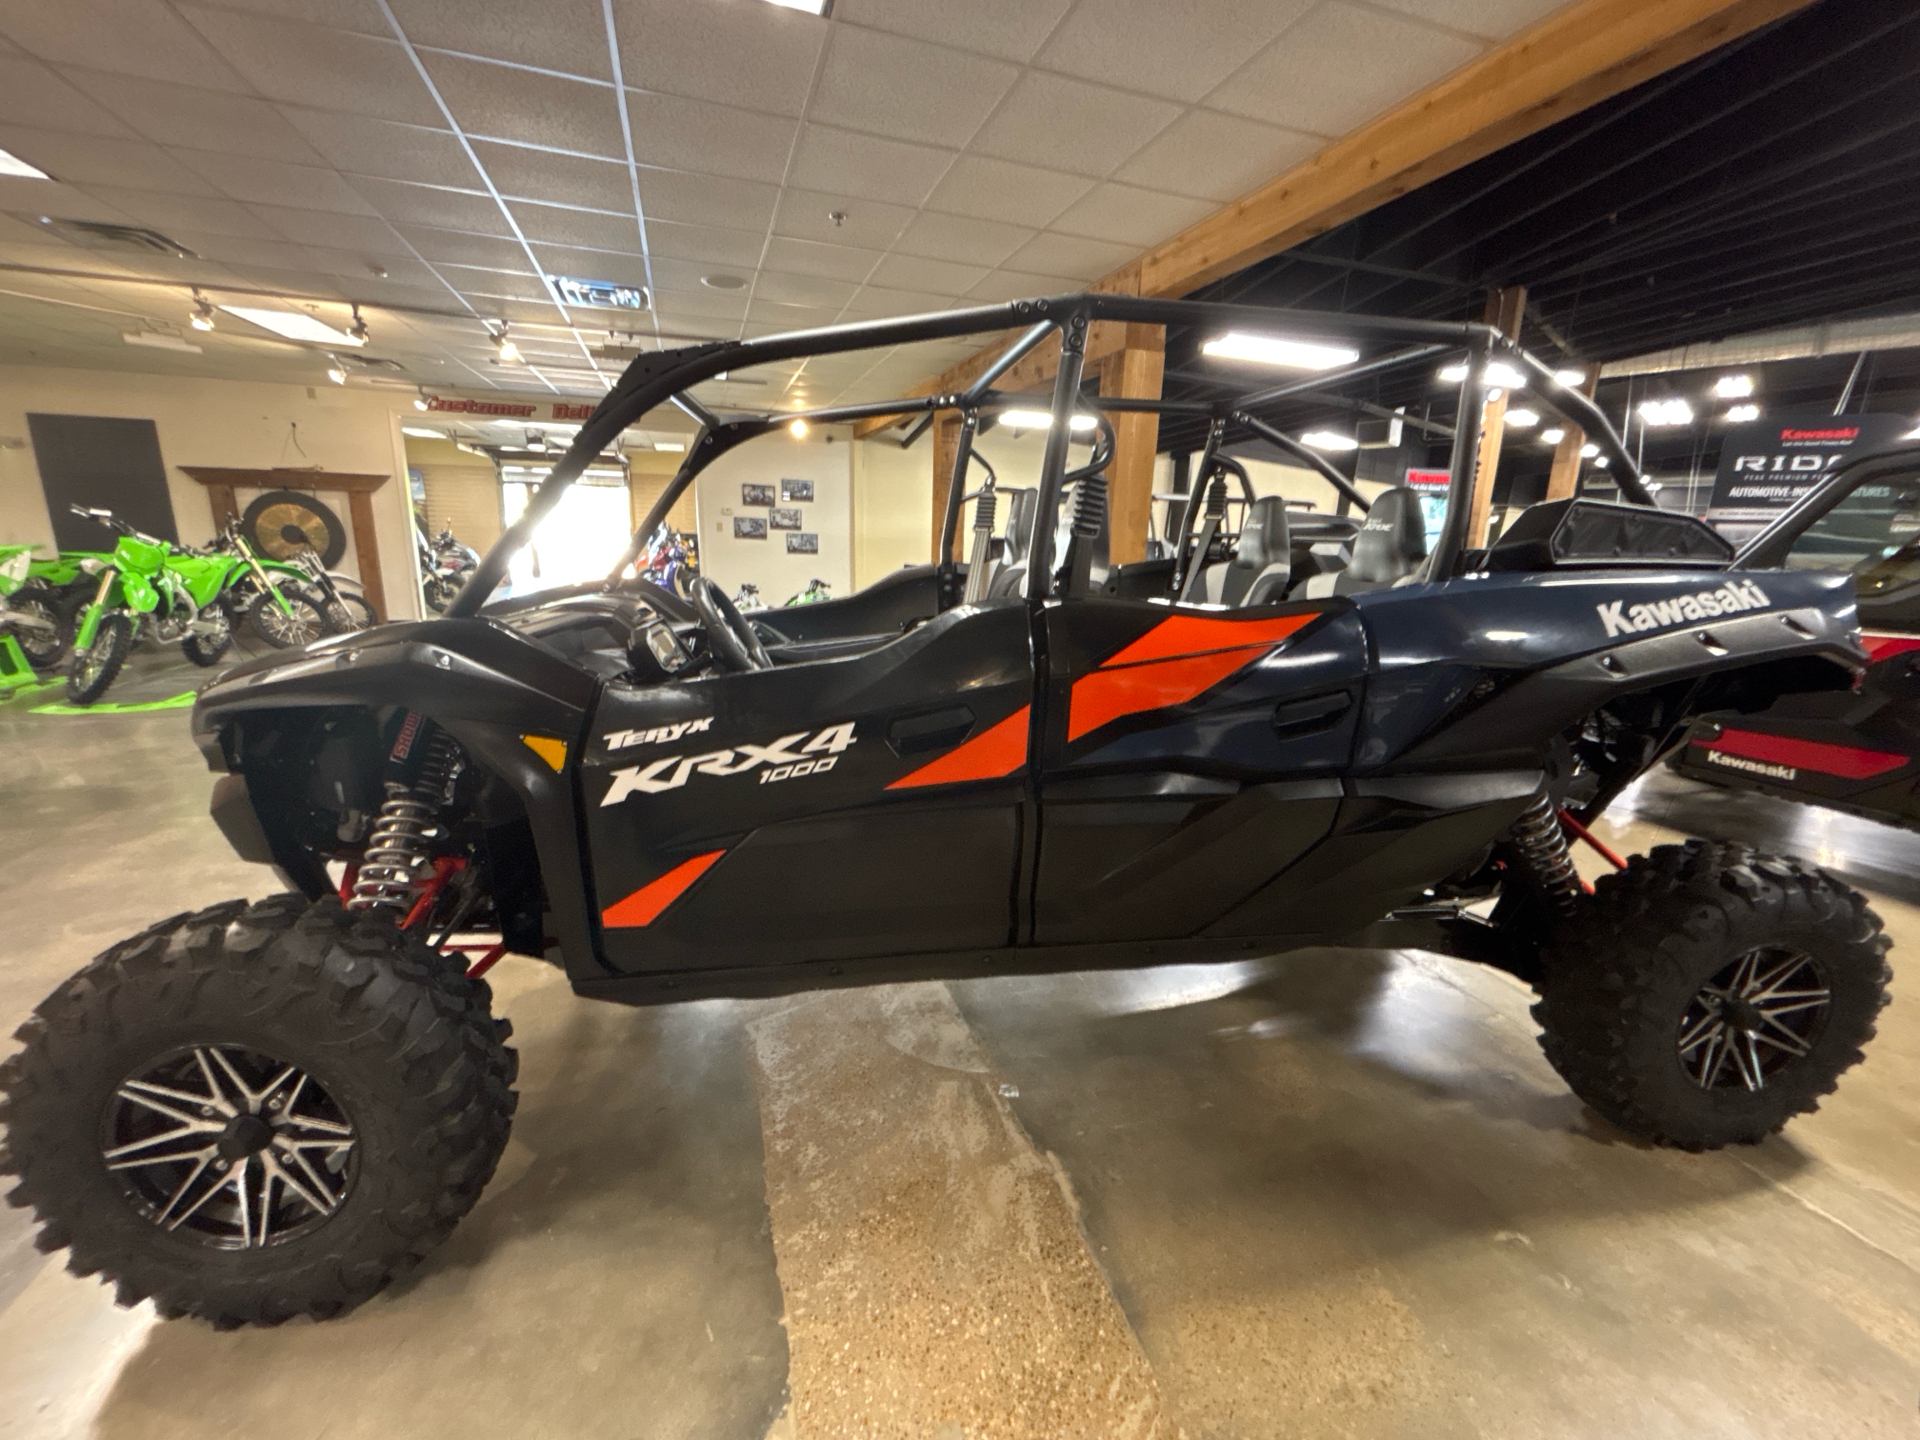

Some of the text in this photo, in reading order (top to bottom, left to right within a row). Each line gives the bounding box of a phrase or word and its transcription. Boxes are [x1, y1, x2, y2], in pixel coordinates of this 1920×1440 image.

[428, 396, 537, 417] Customer
[1780, 427, 1859, 440] Kawasaki
[1734, 454, 1843, 472] RID
[1408, 469, 1451, 484] Kawas
[1596, 579, 1772, 638] Kawasaki
[759, 755, 839, 785] 1000
[1707, 749, 1796, 781] Kawasaki
